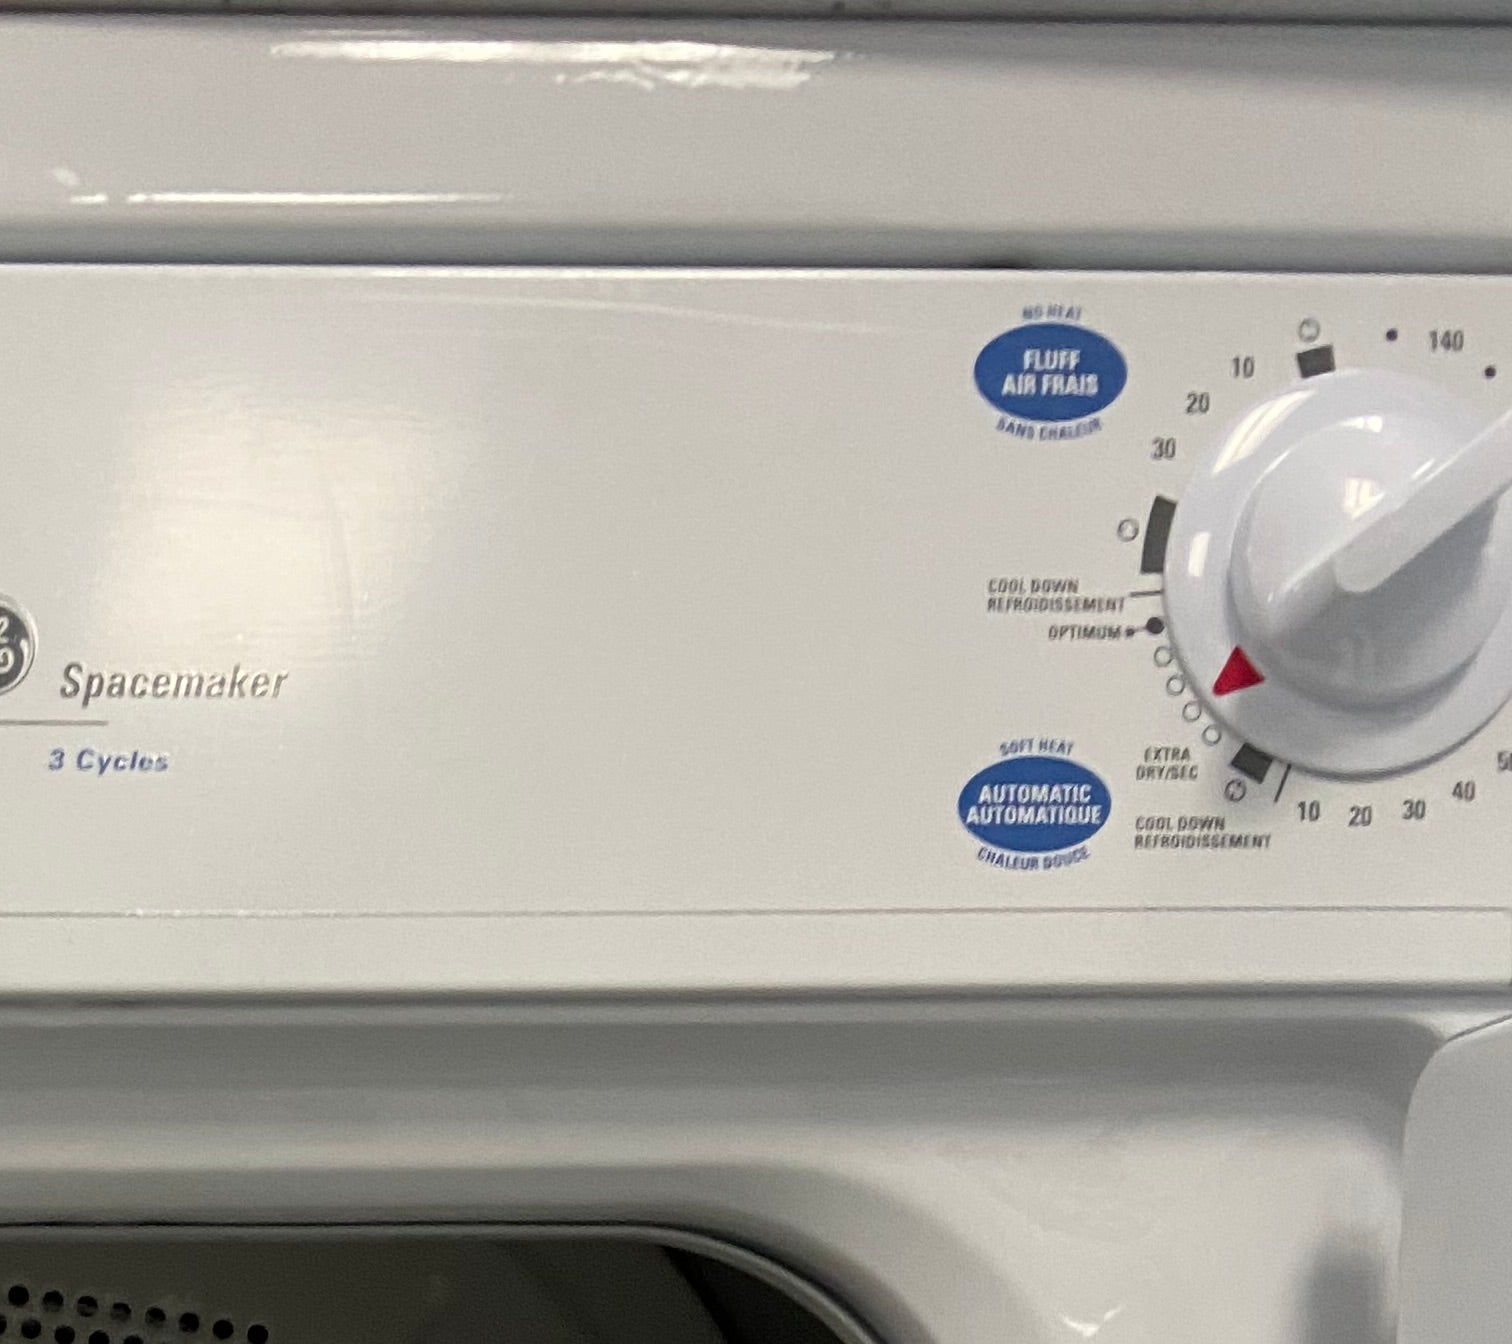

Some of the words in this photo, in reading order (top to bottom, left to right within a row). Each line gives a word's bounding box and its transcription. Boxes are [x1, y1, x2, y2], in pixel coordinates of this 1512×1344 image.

[1428, 328, 1465, 353] 140
[1023, 348, 1081, 372] FLUFF
[1231, 354, 1256, 379] 10
[1000, 372, 1037, 397] AIR
[1040, 372, 1099, 398] FRAIS
[1185, 391, 1211, 416] 20
[1151, 436, 1178, 462] 30
[987, 577, 1027, 595] COOL
[1030, 577, 1079, 595] DOWN
[1047, 624, 1123, 641] OPTIMUM
[58, 660, 289, 709] Spacemaker
[47, 748, 65, 772] 3
[76, 748, 170, 776] Cycles
[1143, 746, 1191, 764] EXTRA
[1135, 764, 1199, 781] DRY/SEC
[977, 783, 1093, 805] AUTOMATIC
[1451, 780, 1477, 803] 40
[965, 804, 1104, 826] AUTOMATIQUE
[1297, 800, 1321, 823] 10
[1347, 805, 1374, 828] 20
[1402, 799, 1427, 822] 30
[1134, 815, 1173, 832] COOL
[1176, 815, 1226, 832] DOWN
